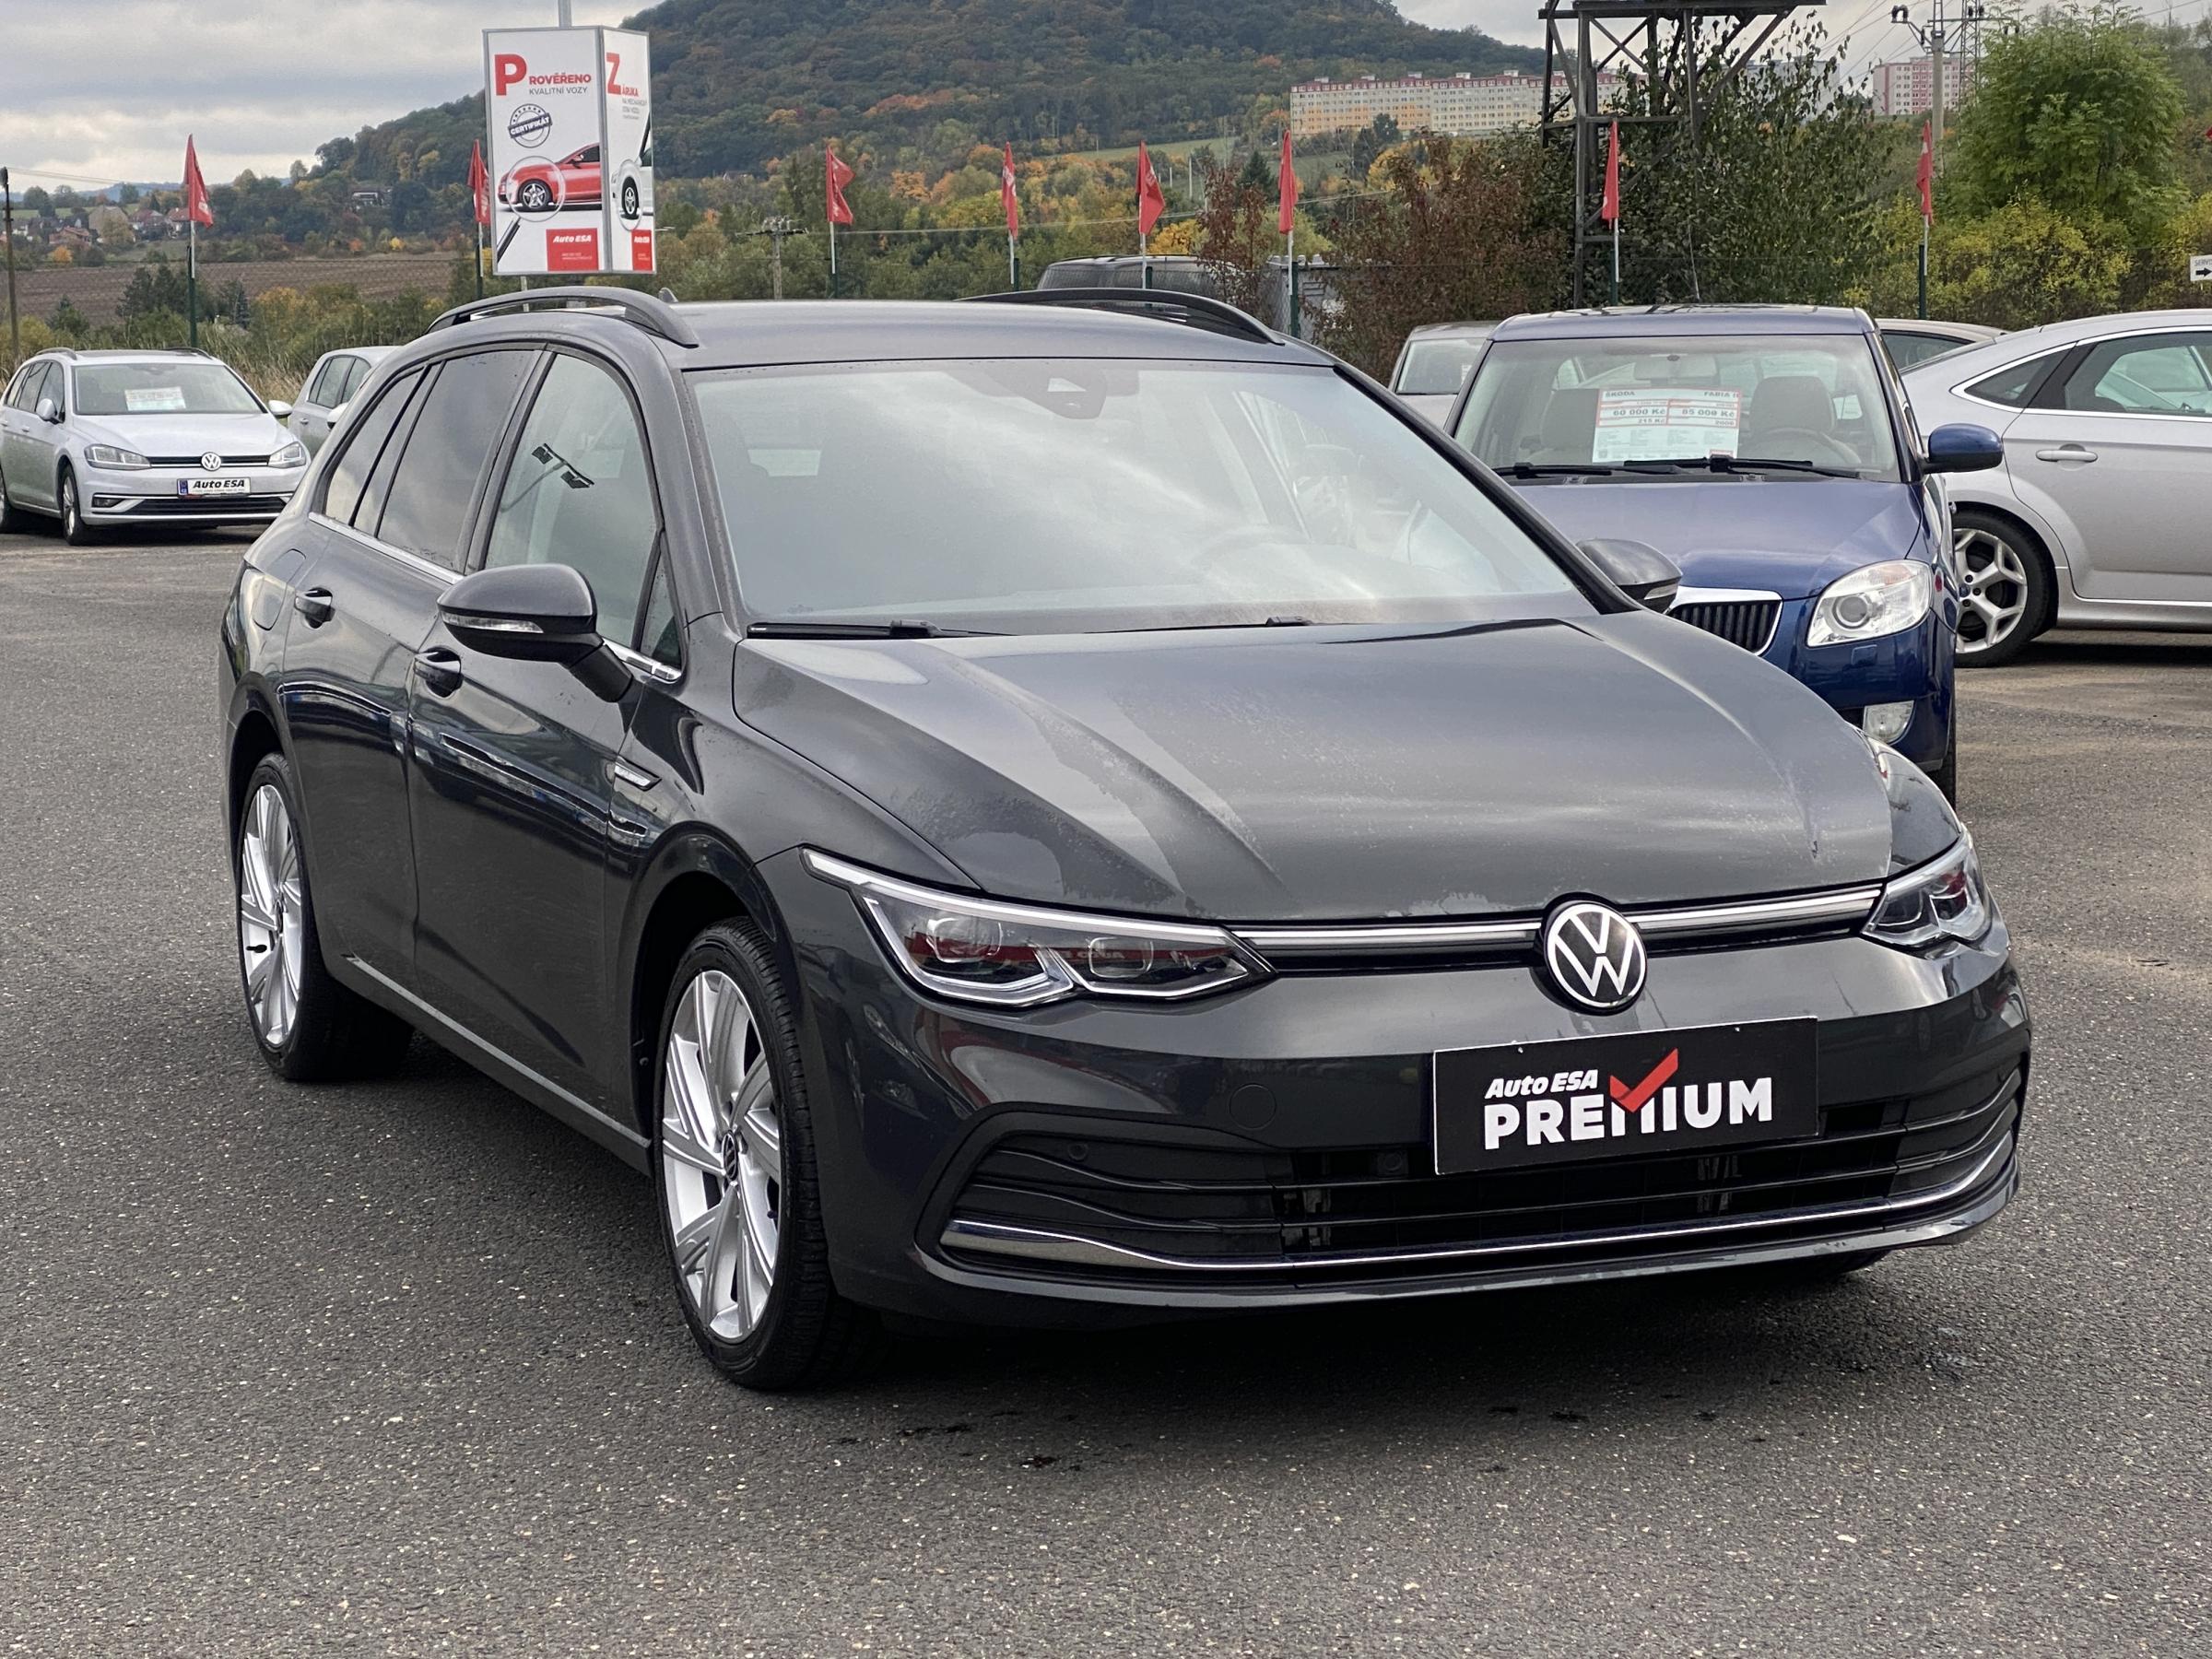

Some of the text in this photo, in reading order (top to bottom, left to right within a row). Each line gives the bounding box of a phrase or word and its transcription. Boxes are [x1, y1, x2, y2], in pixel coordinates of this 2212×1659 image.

[529, 87, 564, 95] KVALITNÍ
[510, 116, 550, 135] CERTIFIKÁT
[193, 479, 245, 488] Auto ESA
[1552, 909, 1641, 999] VW
[1484, 1069, 1598, 1100] Auto ESA
[1484, 1077, 1772, 1150] PREMIUM
